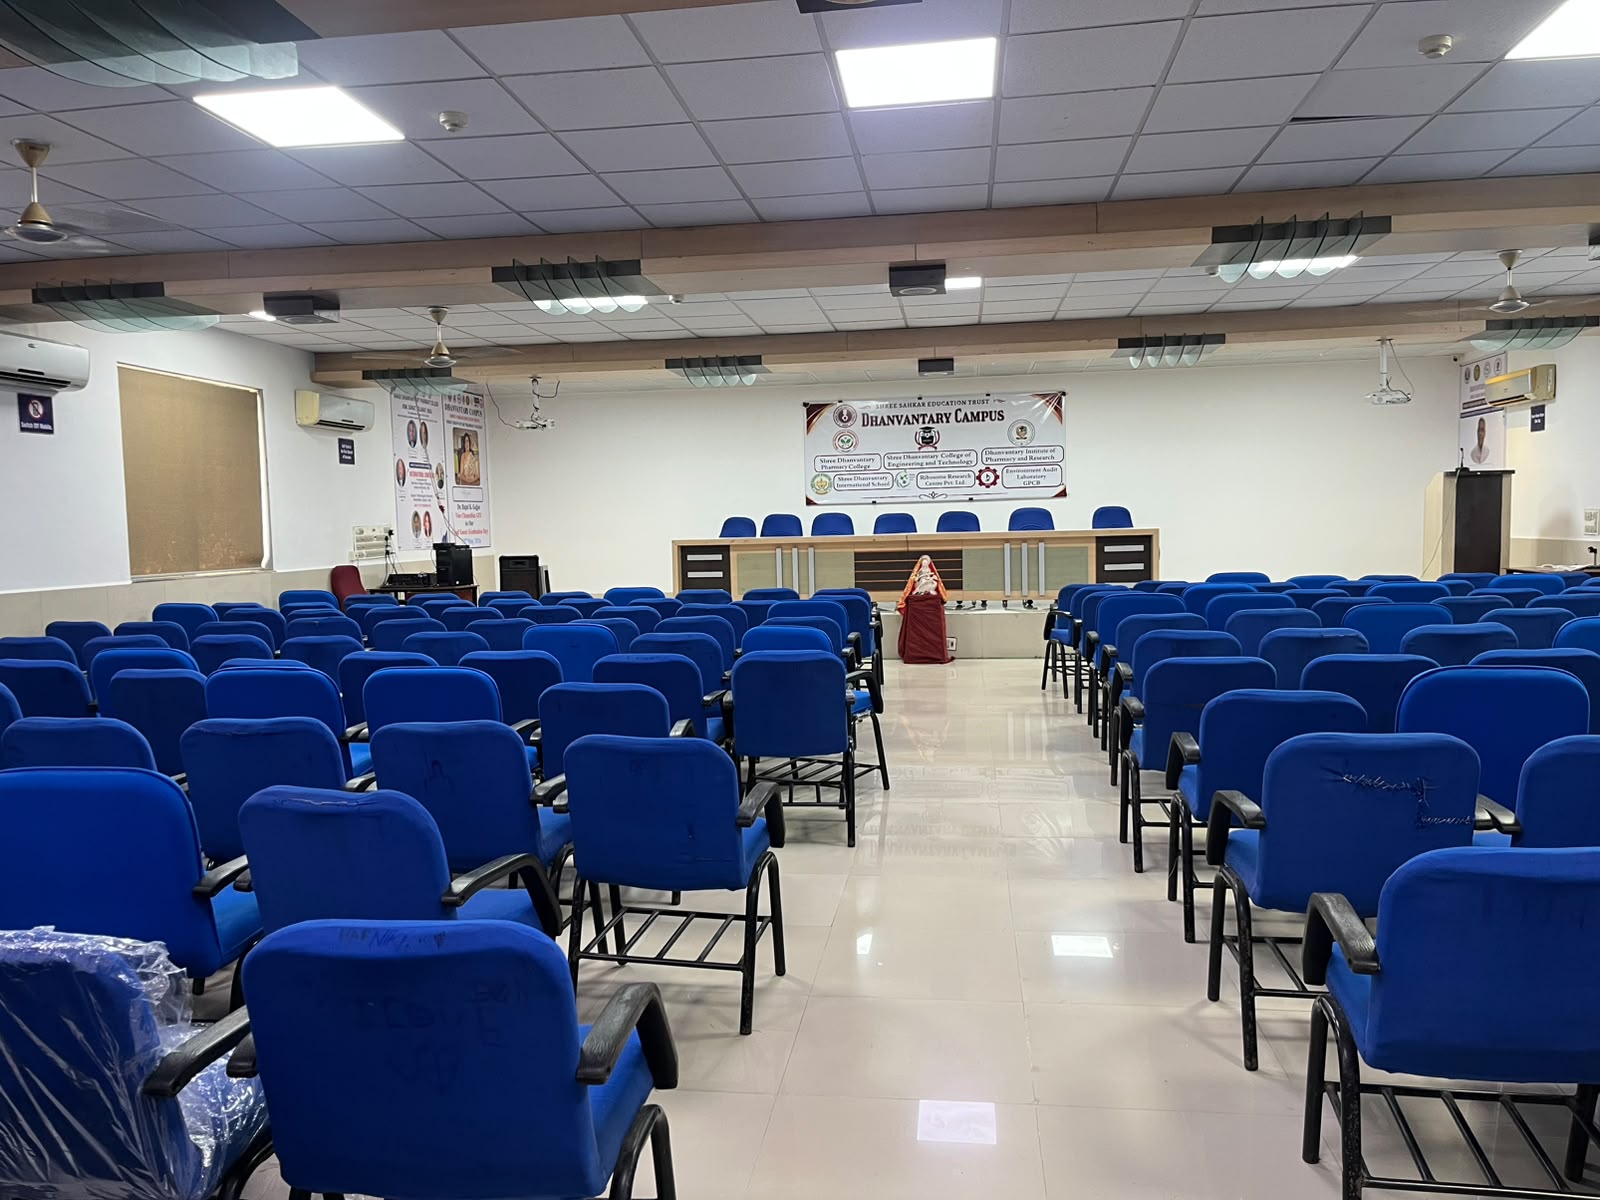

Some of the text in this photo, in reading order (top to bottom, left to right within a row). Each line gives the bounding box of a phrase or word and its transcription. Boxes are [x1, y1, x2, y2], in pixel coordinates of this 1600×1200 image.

[861, 411, 952, 427] DHANVANTARY
[954, 408, 1005, 423] CAMPUS
[837, 457, 875, 465] Dhanvantary
[902, 453, 939, 461] Dhanvantary
[985, 455, 1016, 463] Pharmacy
[848, 463, 871, 471] College
[937, 459, 973, 467] Technology
[853, 474, 888, 482] Dhanvantary
